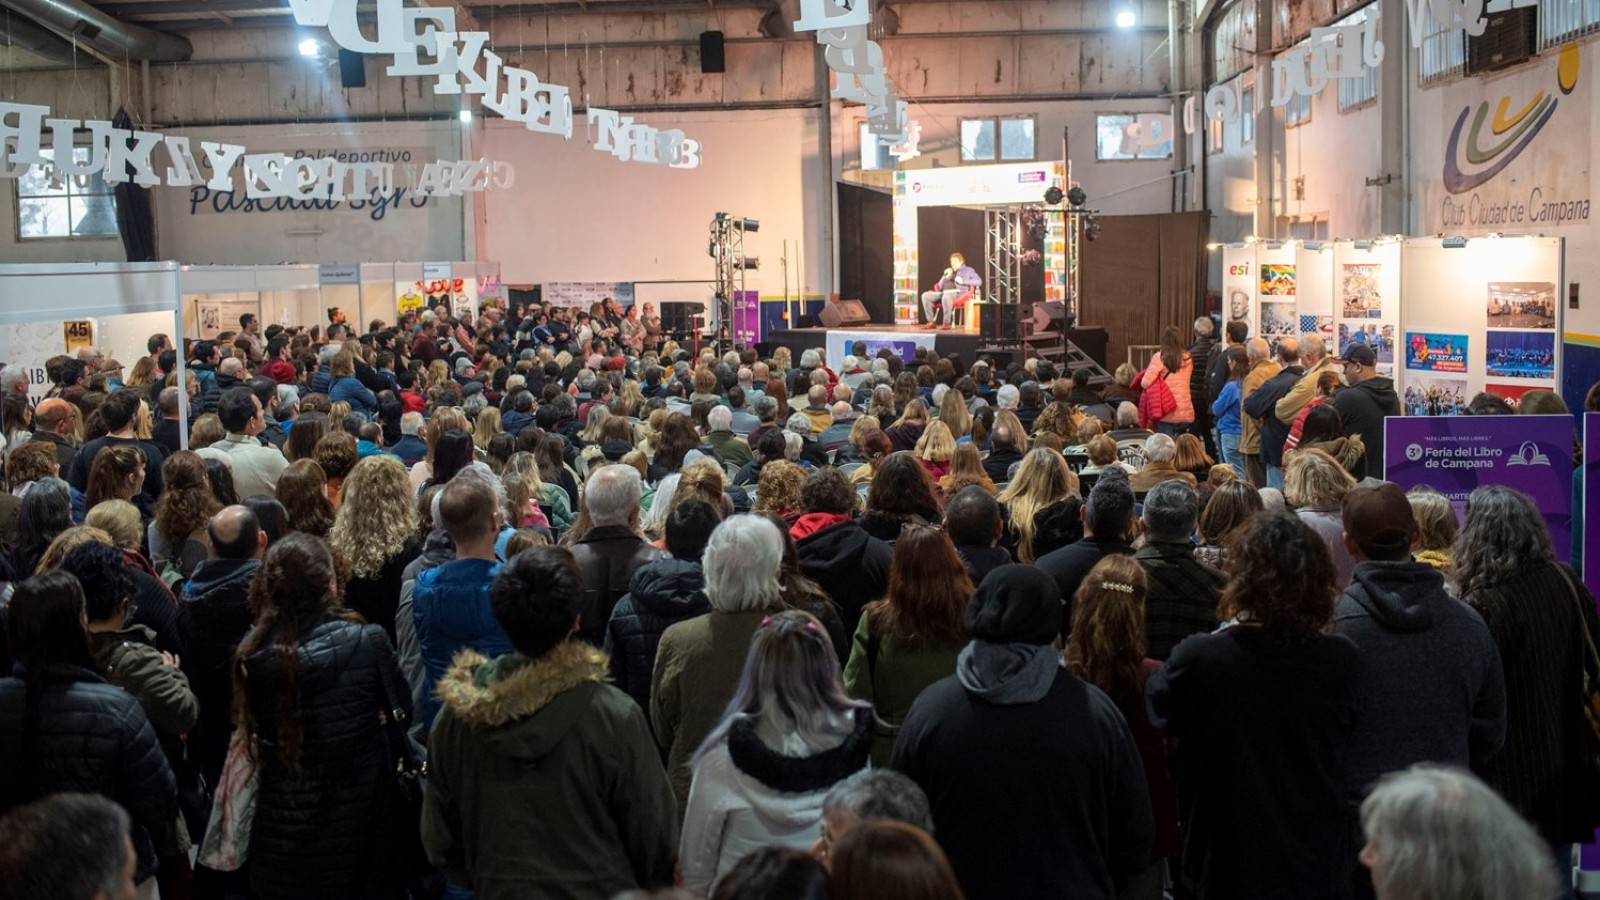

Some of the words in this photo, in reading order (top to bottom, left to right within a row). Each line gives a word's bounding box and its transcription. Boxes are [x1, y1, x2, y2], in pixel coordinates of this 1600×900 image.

[1442, 196, 1465, 226] Club
[1470, 193, 1509, 225] Ciudad
[1510, 200, 1524, 223] de
[1529, 187, 1591, 226] Campana
[1229, 261, 1250, 276] esi
[69, 322, 88, 337] 45
[1425, 447, 1452, 457] Feria
[1454, 447, 1472, 457] del
[1474, 447, 1503, 457] Libro
[1425, 458, 1440, 468] de
[1441, 458, 1494, 470] Campana
